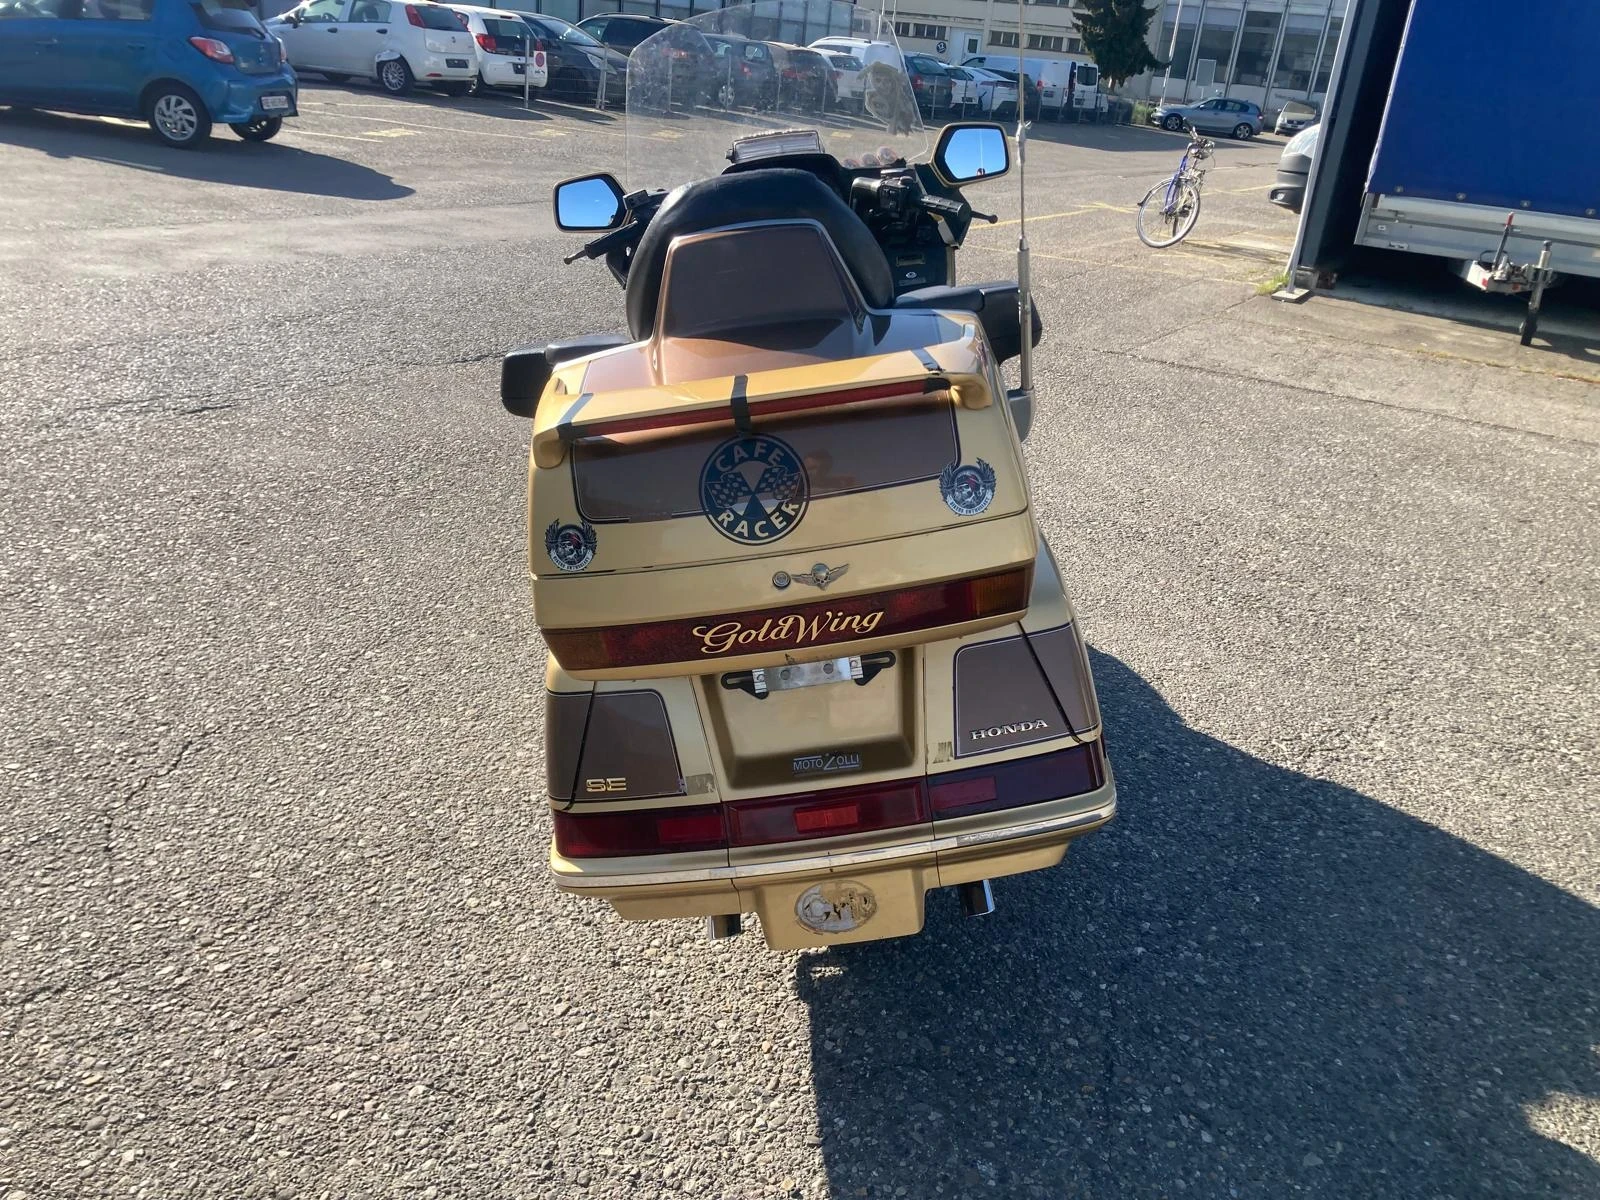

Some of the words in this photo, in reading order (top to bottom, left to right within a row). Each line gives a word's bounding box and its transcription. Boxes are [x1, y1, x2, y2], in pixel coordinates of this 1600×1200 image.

[715, 441, 785, 472] CAFE
[718, 501, 800, 537] RACER
[970, 719, 1048, 740] HONDA
[586, 777, 627, 792] SE
